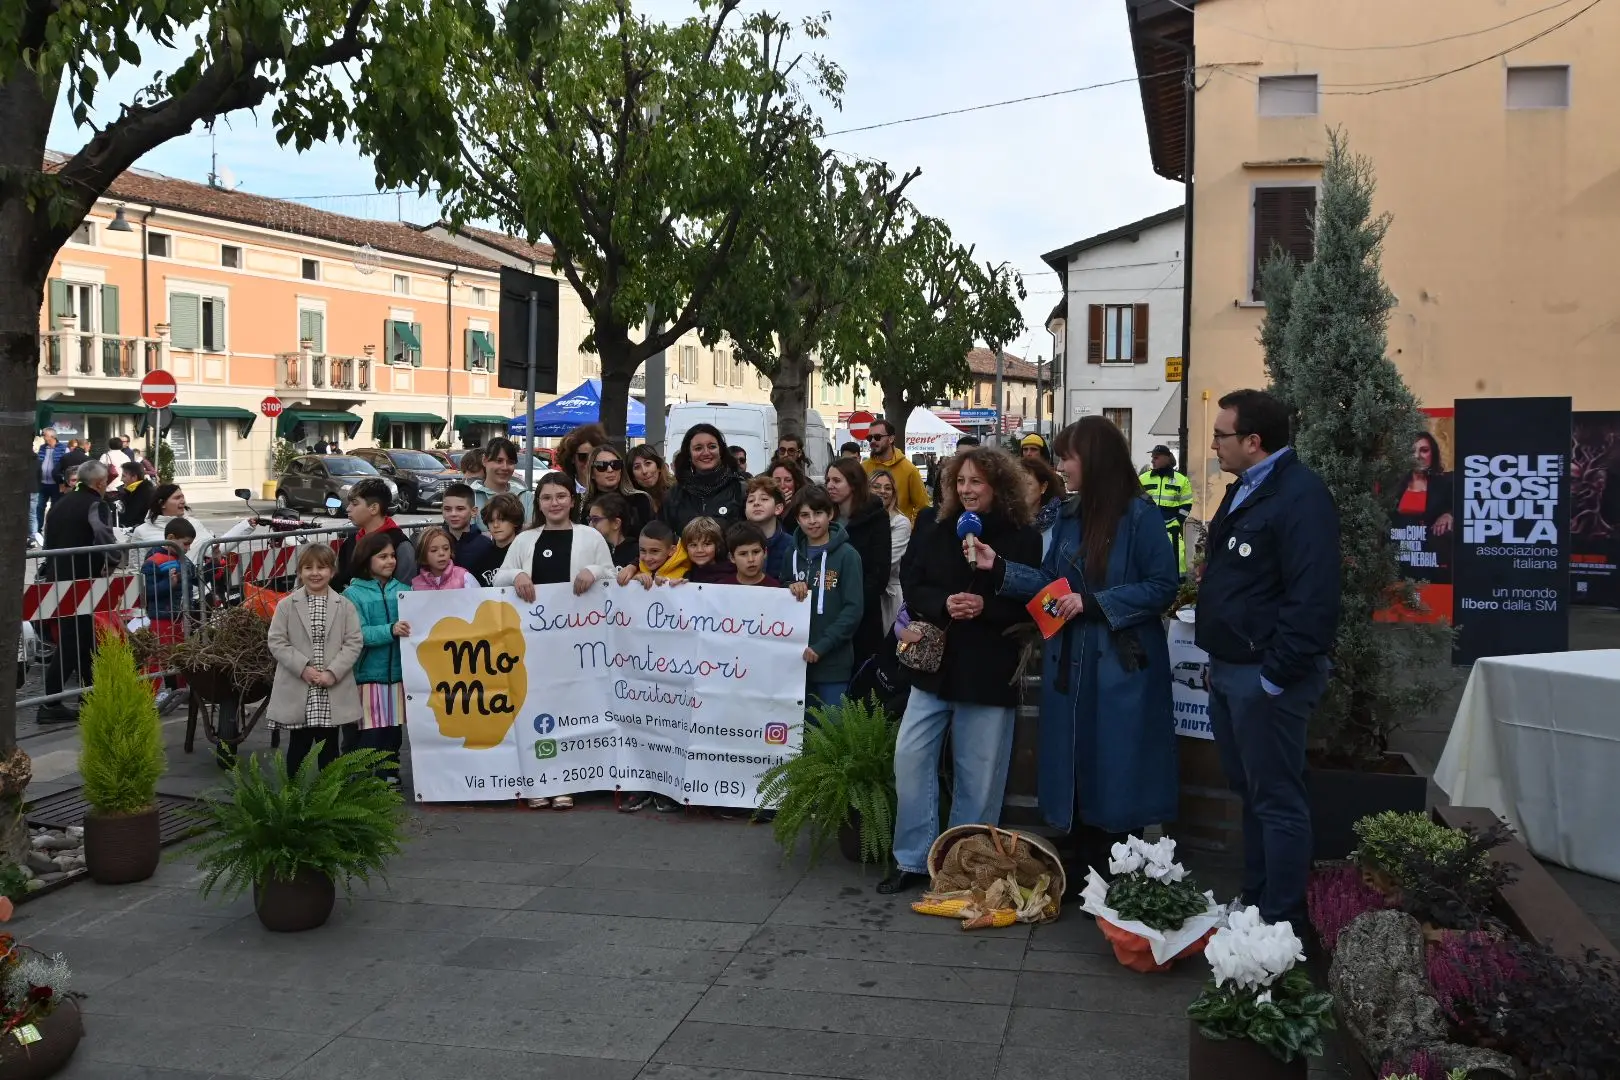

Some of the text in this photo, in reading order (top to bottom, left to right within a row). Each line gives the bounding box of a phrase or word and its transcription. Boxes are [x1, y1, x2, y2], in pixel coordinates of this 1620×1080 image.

[261, 403, 281, 412] STOP
[1464, 454, 1559, 477] SCLE
[1464, 499, 1558, 520] MULT
[1406, 525, 1427, 541] COME
[1476, 545, 1558, 556] associazione
[1513, 557, 1557, 570] italiana
[1492, 588, 1557, 599] un mondo
[1461, 598, 1557, 611] libero dalla SM
[528, 599, 794, 638] Scuola Primaria
[443, 639, 520, 675] Mo
[574, 641, 747, 679] Montessori
[435, 680, 515, 716] Ma
[614, 679, 703, 709] Paritaria
[558, 714, 599, 727] Moma
[605, 711, 642, 725] Scuola
[645, 714, 688, 731] Primaria
[561, 736, 638, 752] 3701563149
[465, 775, 485, 788] Via
[490, 775, 534, 788] Trieste
[539, 773, 548, 785] 4
[562, 765, 604, 782] 25020
[609, 765, 673, 785] Quinzanello
[714, 780, 746, 797] (BS)
